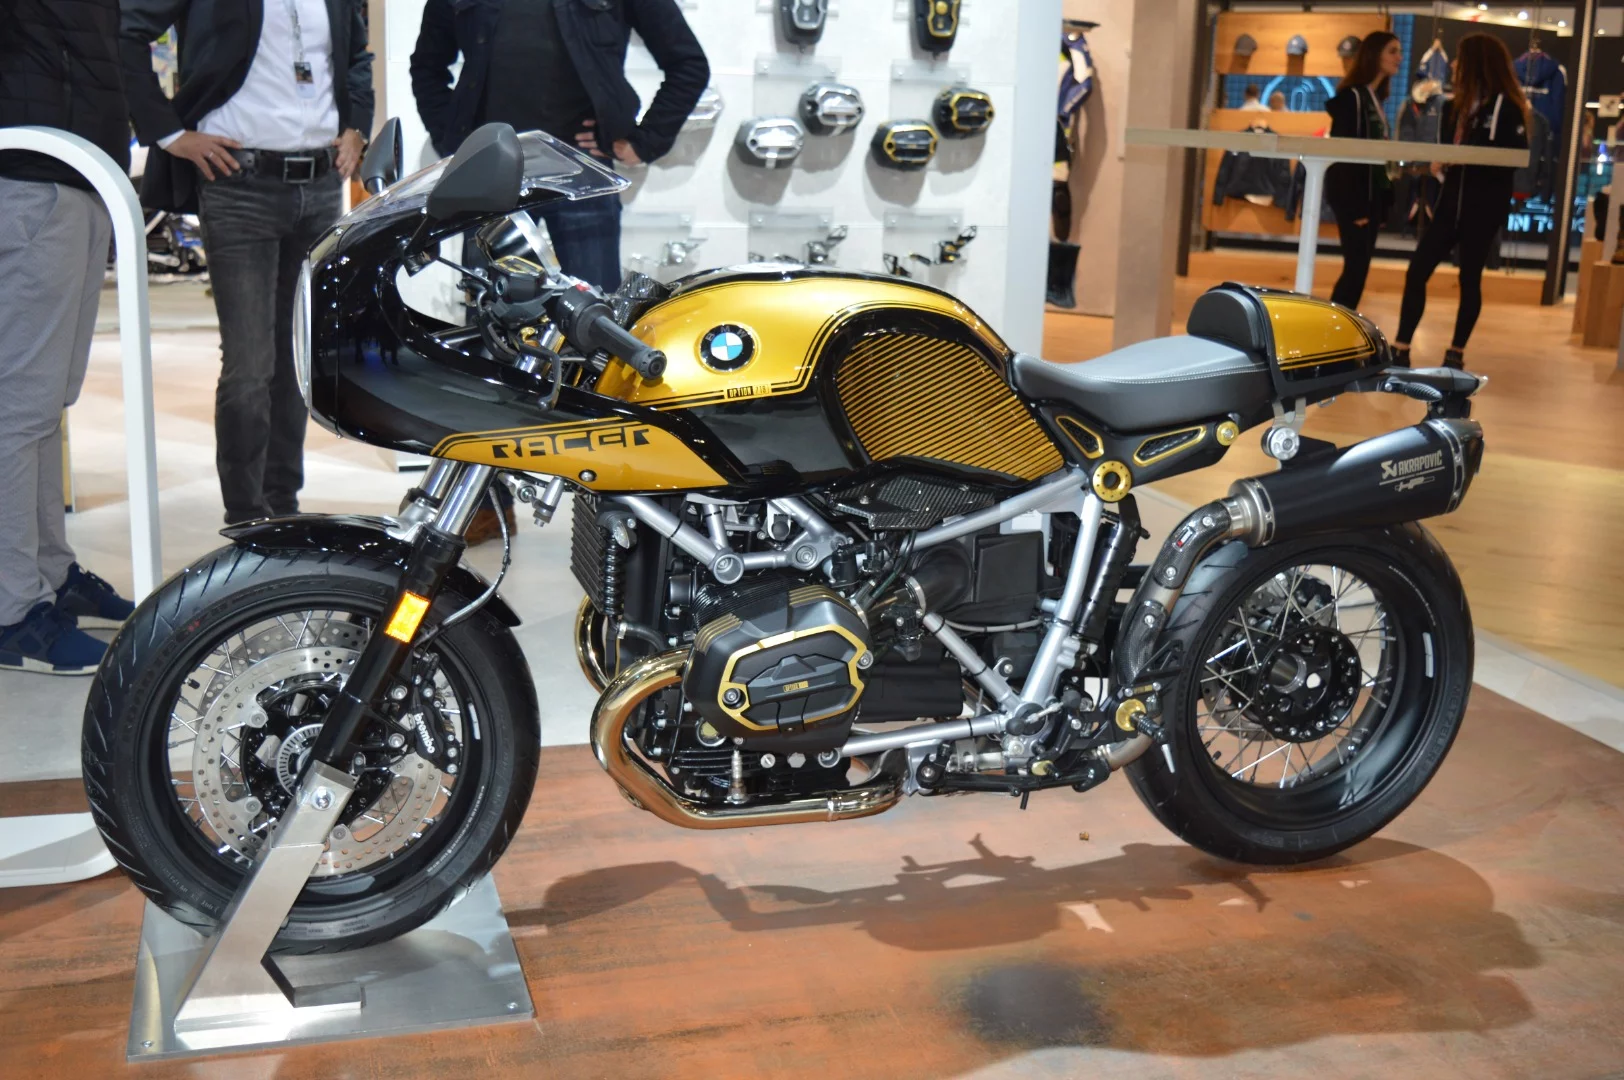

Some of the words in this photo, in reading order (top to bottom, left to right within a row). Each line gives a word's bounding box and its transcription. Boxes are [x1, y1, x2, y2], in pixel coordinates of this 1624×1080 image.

[705, 326, 748, 341] BMW
[492, 427, 650, 459] RACER
[414, 712, 436, 754] brembo
